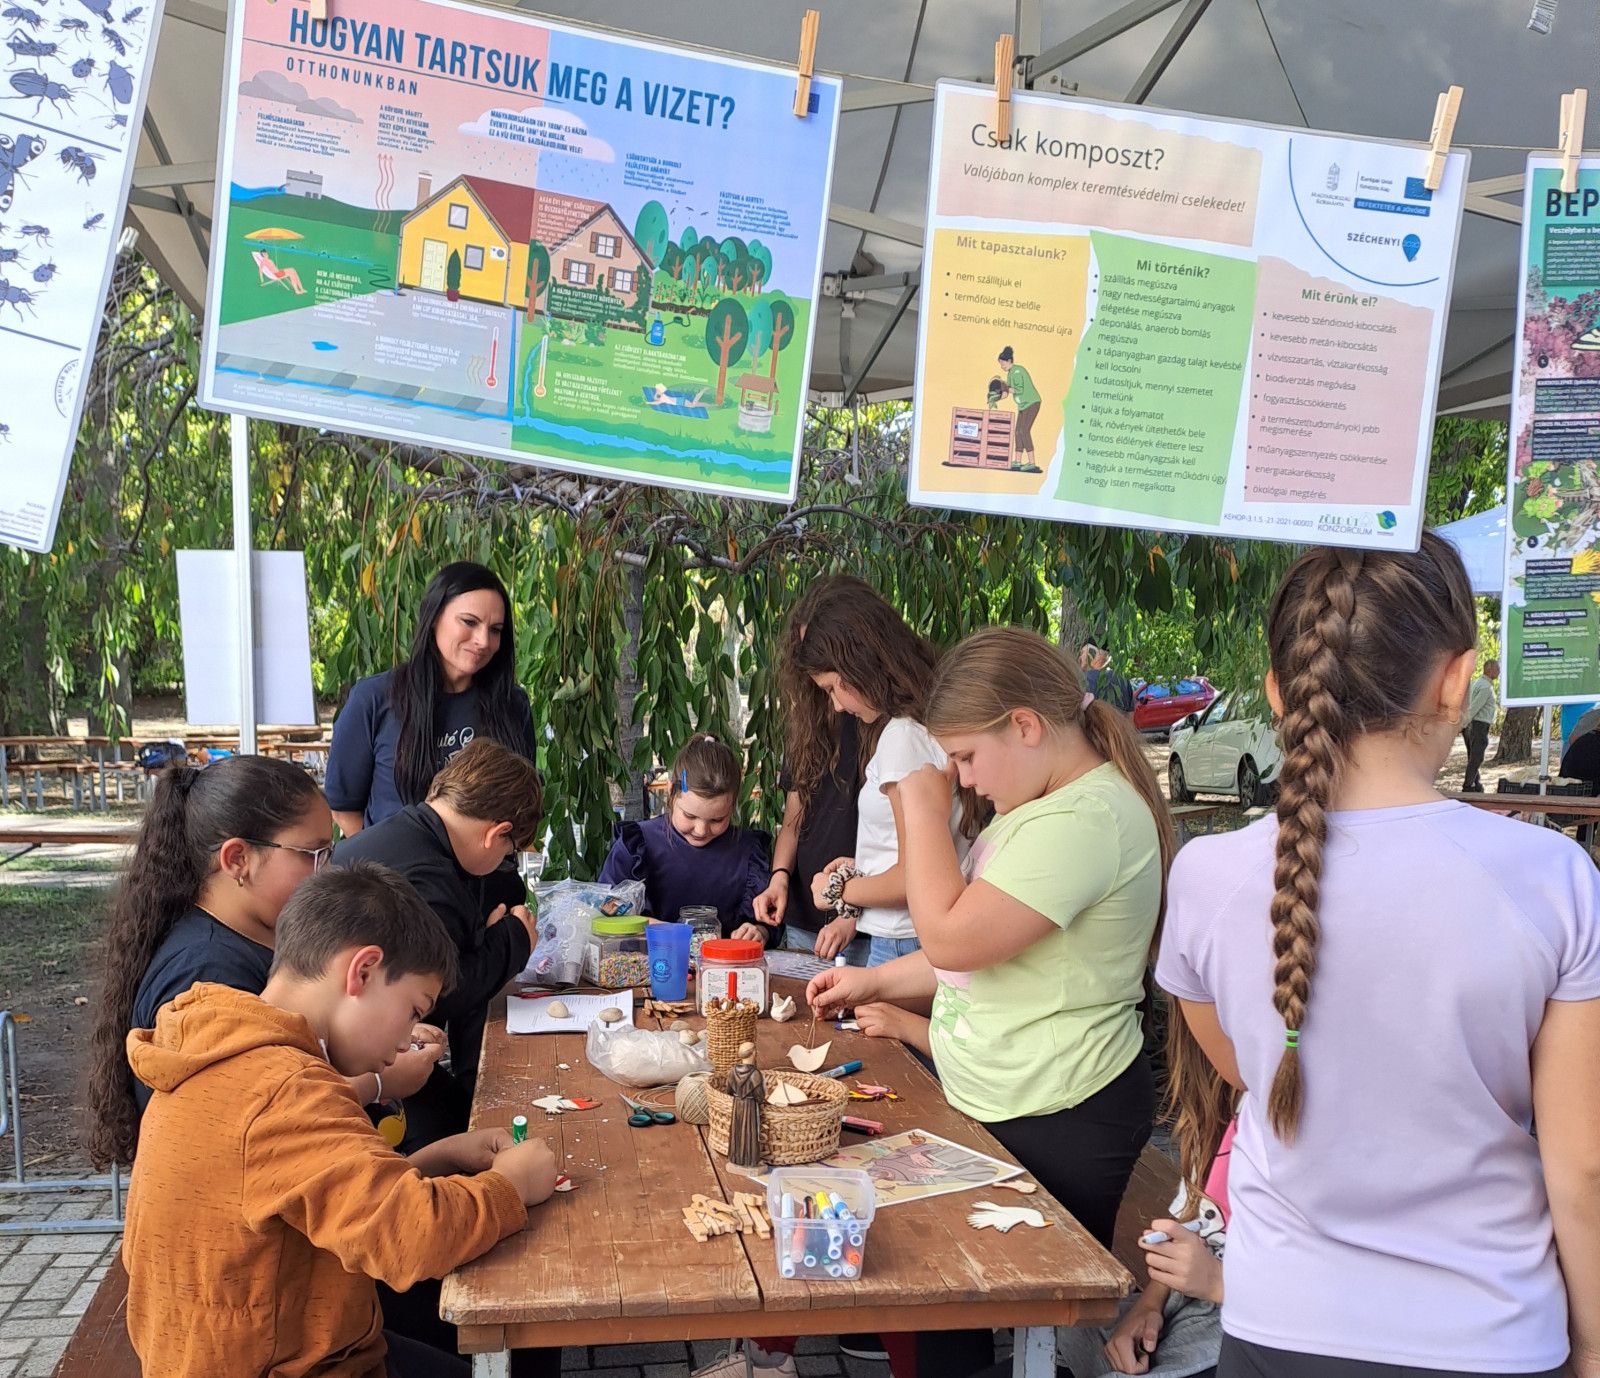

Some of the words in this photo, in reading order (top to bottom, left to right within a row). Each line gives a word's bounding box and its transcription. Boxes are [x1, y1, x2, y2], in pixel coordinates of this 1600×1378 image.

[286, 57, 418, 96] OTTHONUNKBAN
[290, 8, 404, 63] HOGYAN
[415, 32, 541, 92] TARTSUK
[548, 62, 606, 106] MEG
[615, 76, 632, 112] A
[644, 80, 736, 130] VIZET?
[489, 128, 495, 136] EZ
[490, 119, 508, 129] ÉVENTE
[539, 129, 547, 137] VÍZ
[971, 123, 1027, 152] Csak
[1036, 130, 1165, 171] komposzt?
[963, 163, 1024, 184] Valójában
[1027, 174, 1078, 192] komplex
[1081, 180, 1178, 204] teremtésvédelmi
[1181, 192, 1246, 213] cselekedet!
[957, 236, 977, 248] Mit
[981, 240, 1067, 260] tapasztalunk?
[1347, 232, 1400, 246] SZÉCHENYI
[1137, 259, 1151, 272] Mi
[1155, 260, 1210, 279] történik?
[956, 272, 974, 282] nem
[978, 274, 1012, 288] szállítjuk
[1014, 280, 1022, 288] el
[1104, 273, 1135, 286] szállítás
[1137, 278, 1178, 291] megúszva
[954, 292, 995, 305] termőföld
[998, 298, 1017, 307] lesz
[1016, 299, 1040, 311] belőle
[1102, 288, 1122, 299] nagy
[1124, 290, 1201, 308] nedvességtartalmú
[1202, 302, 1236, 314] anyagok
[1301, 288, 1321, 300] Mit
[1324, 291, 1359, 306] érünk
[1361, 296, 1378, 308] el?
[1101, 303, 1140, 318] elégetése
[1142, 308, 1182, 321] megúszva
[953, 312, 990, 325] szemünk
[992, 316, 1011, 328] előtt
[1014, 319, 1054, 332] hasznosul
[1056, 326, 1072, 336] újra
[1100, 317, 1143, 332] deponálás,
[1145, 324, 1180, 335] anaerob
[1182, 327, 1211, 339] bomlás
[1272, 311, 1309, 325] kevesebb
[1312, 317, 1397, 334] széndioxid-kibocsátás
[1098, 332, 1138, 345] megúszva
[1270, 332, 1308, 345] kevesebb
[1309, 336, 1378, 352] metán-kibocsátás
[1095, 361, 1109, 371] kell
[1110, 362, 1141, 374] locsolni
[1104, 347, 1156, 361] tápanyagban
[1157, 353, 1186, 367] gazdag
[1188, 357, 1208, 369] talajt
[1210, 359, 1242, 371] kevésbé
[1267, 352, 1325, 368] vízvisszatartás,
[1327, 359, 1388, 376] víztakarékosság
[1094, 376, 1143, 390] tudatosítjuk,
[1145, 382, 1175, 394] mennyi
[1176, 386, 1214, 397] szemetet
[1265, 373, 1315, 387] biodiverzitás
[1317, 377, 1356, 391] megóvása
[1092, 390, 1133, 402] termelünk
[1263, 393, 1347, 411] fogyasztáscsökkentés
[1091, 403, 1113, 416] látjuk
[1122, 407, 1164, 421] folyamatot
[1089, 418, 1103, 429] fák,
[1105, 420, 1143, 434] növények
[1146, 424, 1186, 437] ültethetők
[1188, 428, 1206, 439] bele
[1260, 425, 1313, 438] megismerése
[1362, 424, 1380, 435] jobb
[1088, 432, 1114, 443] fontos
[1116, 435, 1153, 449] élőlények
[1155, 439, 1186, 451] élettere
[1188, 443, 1204, 453] lesz
[1087, 447, 1125, 459] kevesebb
[1127, 449, 1181, 465] műanyagzsák
[1182, 455, 1196, 465] kell
[1257, 444, 1338, 462] műanyagszennyezés
[1340, 452, 1388, 465] csökkentése
[1086, 462, 1116, 475] hagyjuk
[1125, 465, 1173, 479] természetet
[1174, 470, 1210, 482] működni
[1255, 464, 1336, 481] energiatakarékosság
[1085, 476, 1108, 487] ahogy
[1132, 481, 1175, 493] megalkotta
[1253, 484, 1288, 498] ökológiai
[1318, 524, 1372, 535] KONZORCIUM
